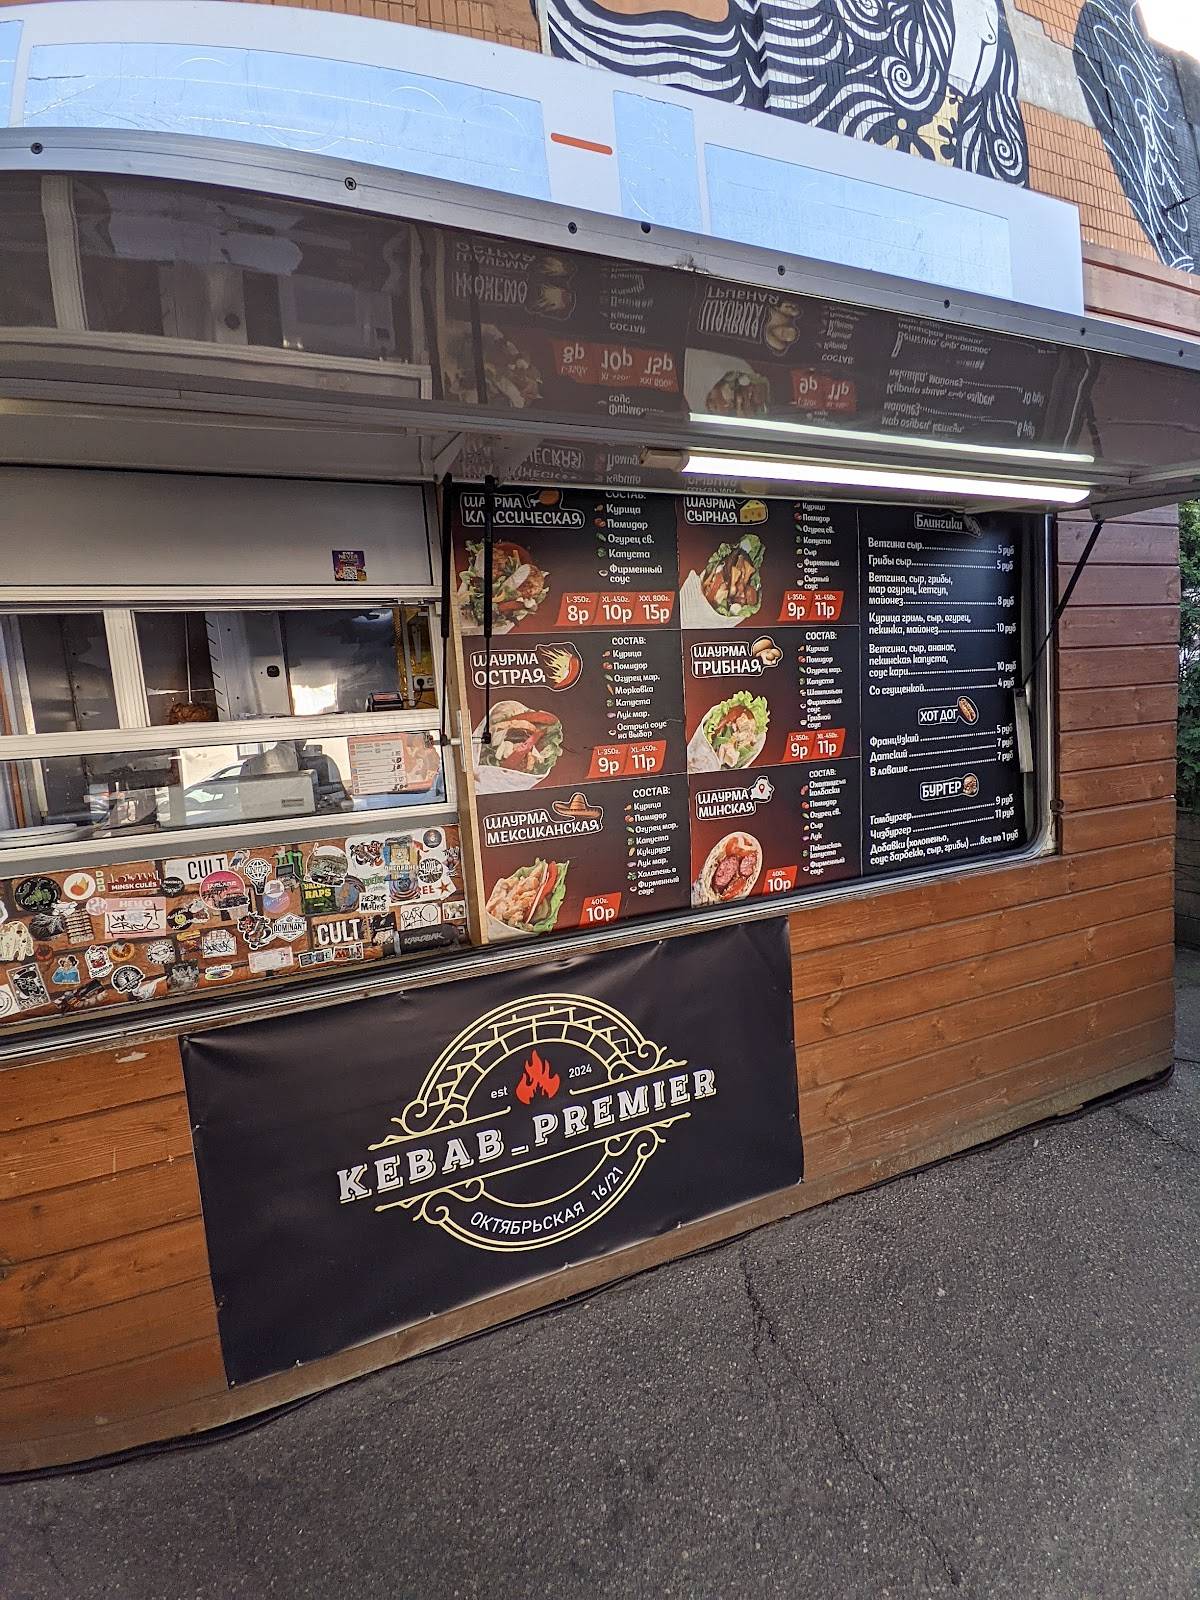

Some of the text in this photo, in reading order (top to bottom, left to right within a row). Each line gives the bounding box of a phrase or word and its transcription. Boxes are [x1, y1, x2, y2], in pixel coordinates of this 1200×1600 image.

[463, 496, 522, 508] ШАРМА
[687, 497, 736, 509] ШАУРМА
[606, 504, 641, 515] Курица
[687, 510, 738, 523] СЫРНАЯ
[607, 519, 648, 530] Помидор
[608, 534, 654, 545] Огурец св.
[608, 549, 650, 560] Капуста
[1003, 544, 1015, 556] руб
[610, 564, 662, 574] Фирменный
[868, 555, 1013, 572] Грибы 5 руб
[610, 576, 630, 584] соус
[868, 586, 886, 595] мар
[1003, 596, 1015, 607] руб
[568, 604, 670, 624] 8р 10р 15р
[788, 602, 835, 620] 9р 11р
[869, 612, 900, 624] Курица
[996, 623, 1004, 632] 10
[1005, 623, 1016, 634] руб
[612, 637, 646, 645] СОСТАВ:
[806, 632, 837, 640] СОСТАВ:
[612, 650, 642, 659] Курица
[693, 645, 747, 658] ШАУРМА
[473, 653, 539, 667] ШАУРМА
[869, 656, 912, 666] пекинская
[694, 659, 762, 675] ГРИБНАЯ
[869, 661, 1016, 679] соус 10 руб
[474, 668, 546, 686] ОСТРАЯ
[614, 674, 660, 683] Огурец мар.
[615, 685, 653, 695] Морковка
[869, 685, 880, 696] Со
[1003, 677, 1015, 688] руб
[617, 711, 650, 720] Лук мар.
[920, 709, 958, 722] ХОТ ДОГ
[617, 721, 667, 731] Острый соус
[996, 725, 1001, 733] 5
[1002, 724, 1013, 735] руб
[791, 740, 836, 759] 9р 11р
[870, 738, 1013, 763] Датский 7 руб
[598, 755, 656, 775] 9р 11р
[870, 751, 1013, 776] В лаваше 7 руб
[809, 769, 836, 778] СОСТАВ:
[633, 786, 671, 798] СОСТАВ:
[922, 781, 962, 798] БУРГЕР
[698, 790, 748, 804] ШАУРМА
[995, 794, 1013, 806] 9 руб
[634, 801, 661, 811] Курица
[699, 802, 754, 817] МИНСКАЯ
[485, 812, 549, 829] ШАУРМА
[634, 813, 667, 822] Помидор
[870, 807, 1015, 840] Чизбургер 11 руб
[487, 820, 600, 845] МЕКСИКАНСКАЯ
[635, 825, 661, 834] Огурец
[636, 835, 669, 845] Капуста
[637, 846, 671, 856] Кукуруза
[870, 854, 889, 865] соус
[993, 835, 1002, 843] по
[1006, 829, 1019, 841] руб
[870, 839, 905, 855] Добавки
[187, 857, 225, 879] CULT
[637, 859, 651, 868] Лук
[638, 876, 679, 888] Фирменный
[768, 878, 791, 893] 10р
[638, 888, 654, 896] соус
[586, 905, 615, 922] 10р
[317, 919, 360, 945] CULT
[568, 1063, 592, 1079] 2024
[490, 1085, 509, 1100] est
[470, 1165, 623, 1235] ОКТЯБРЬСКАЯ 16/21
